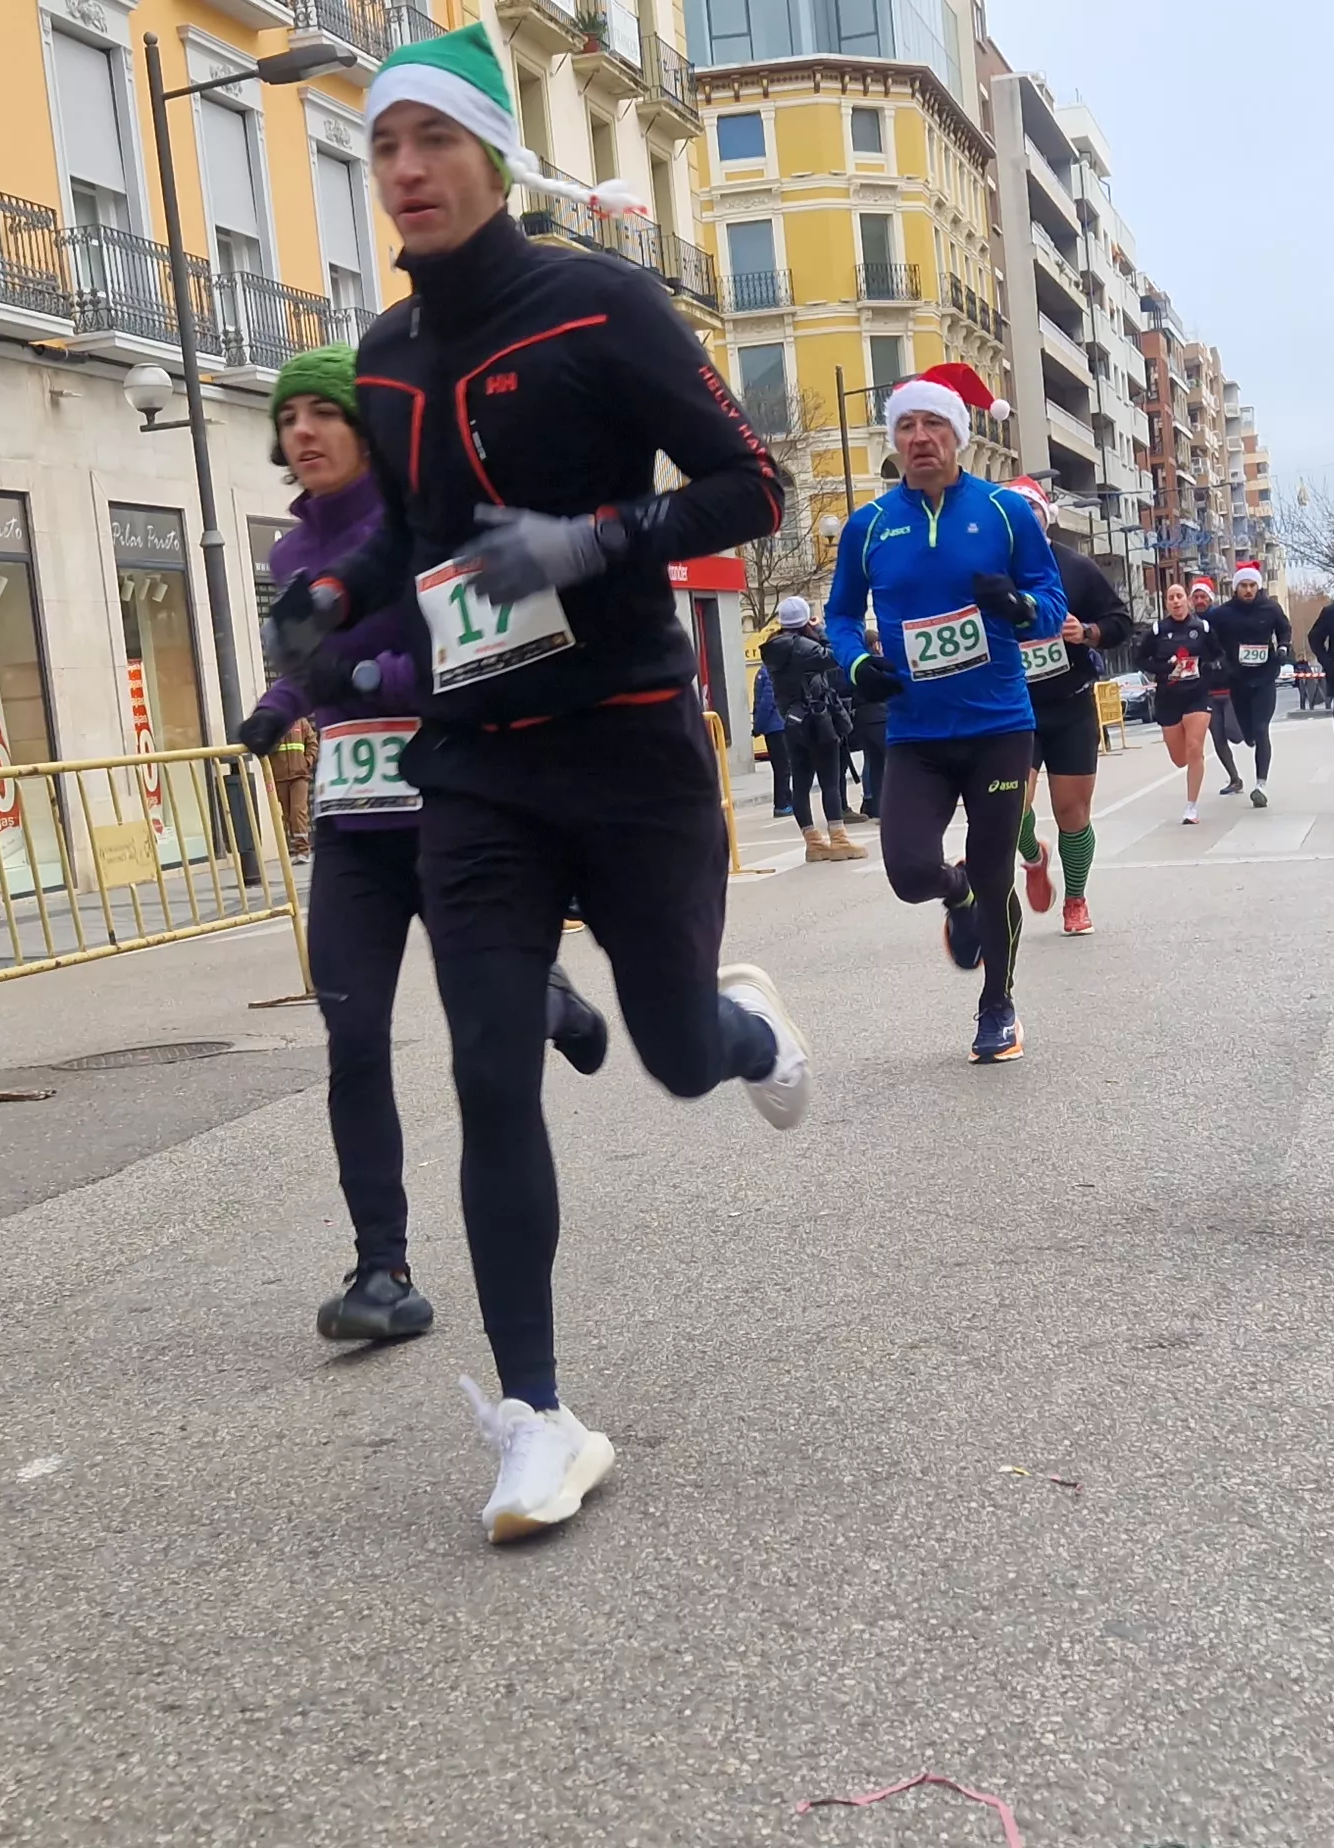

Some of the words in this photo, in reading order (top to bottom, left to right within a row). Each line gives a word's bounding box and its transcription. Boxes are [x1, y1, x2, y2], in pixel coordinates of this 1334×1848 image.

[698, 365, 741, 418] HELLY
[915, 619, 981, 663] 289
[1243, 649, 1266, 660] 290
[329, 735, 407, 786] 193
